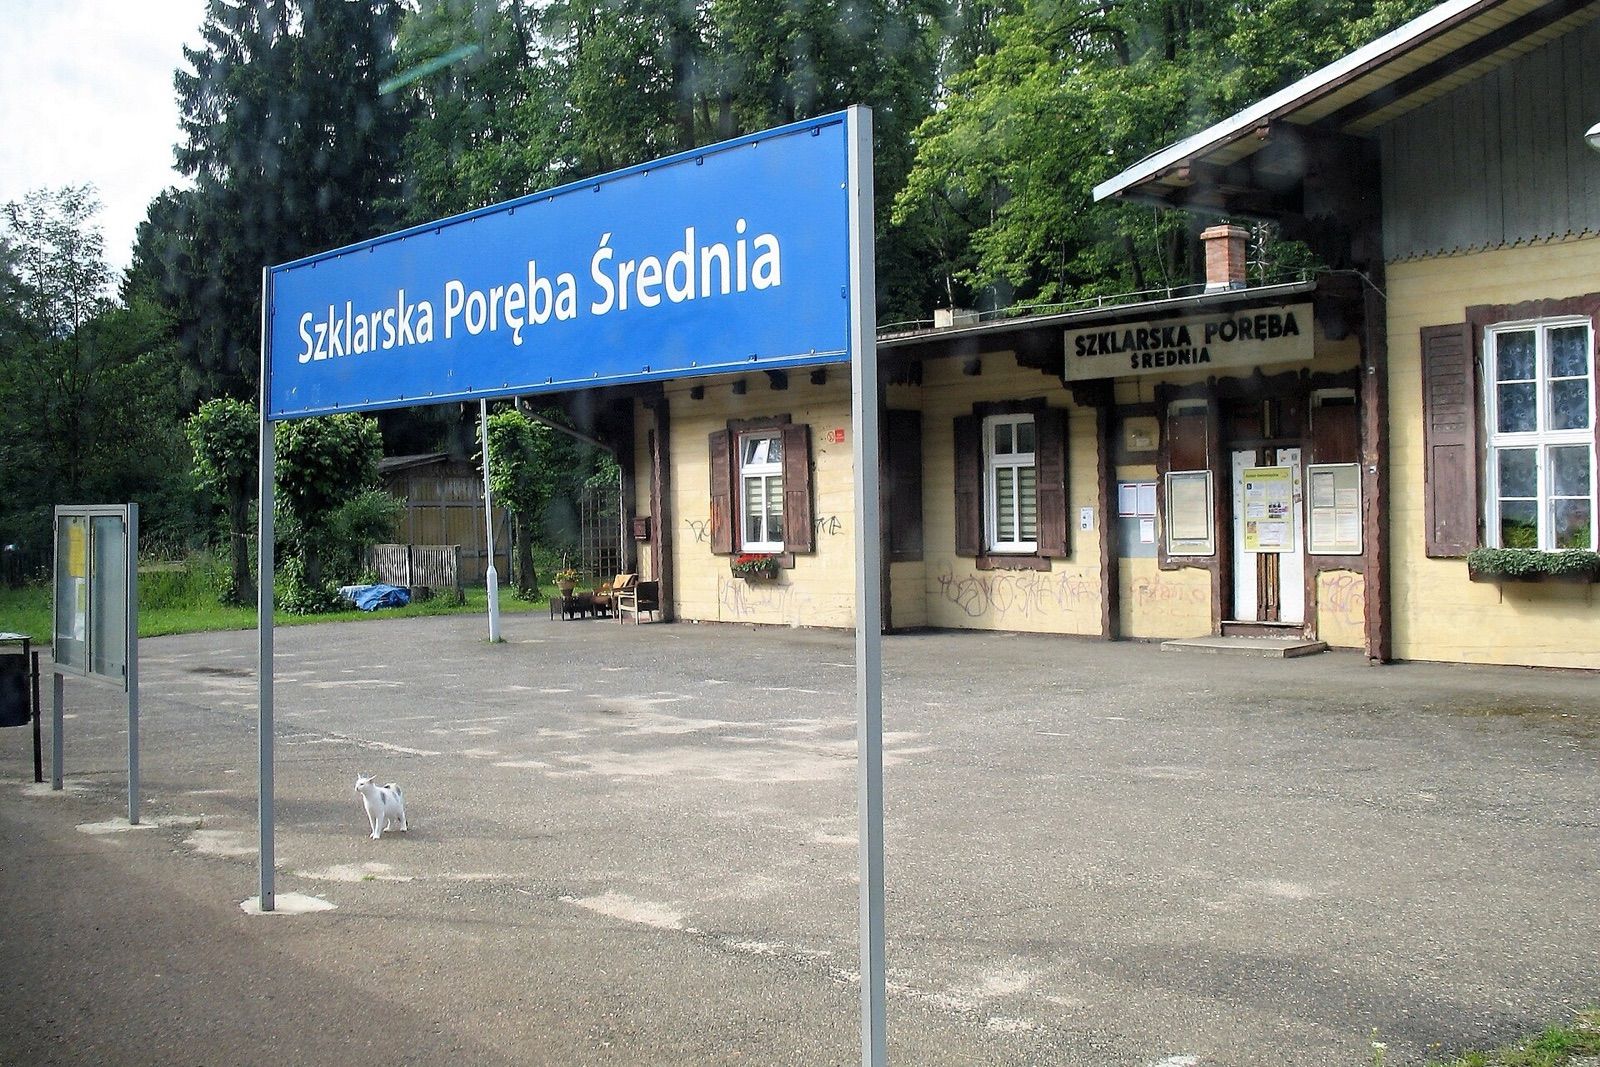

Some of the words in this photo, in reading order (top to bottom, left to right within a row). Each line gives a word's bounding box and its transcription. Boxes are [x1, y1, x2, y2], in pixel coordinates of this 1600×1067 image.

[298, 289, 433, 364] Szklarska
[444, 260, 577, 346] Poręba
[590, 217, 782, 316] Średnia
[1075, 324, 1192, 357] SZKLARSKA
[1204, 311, 1300, 345] PORĘBA
[1130, 346, 1211, 369] ŚREDNIA
